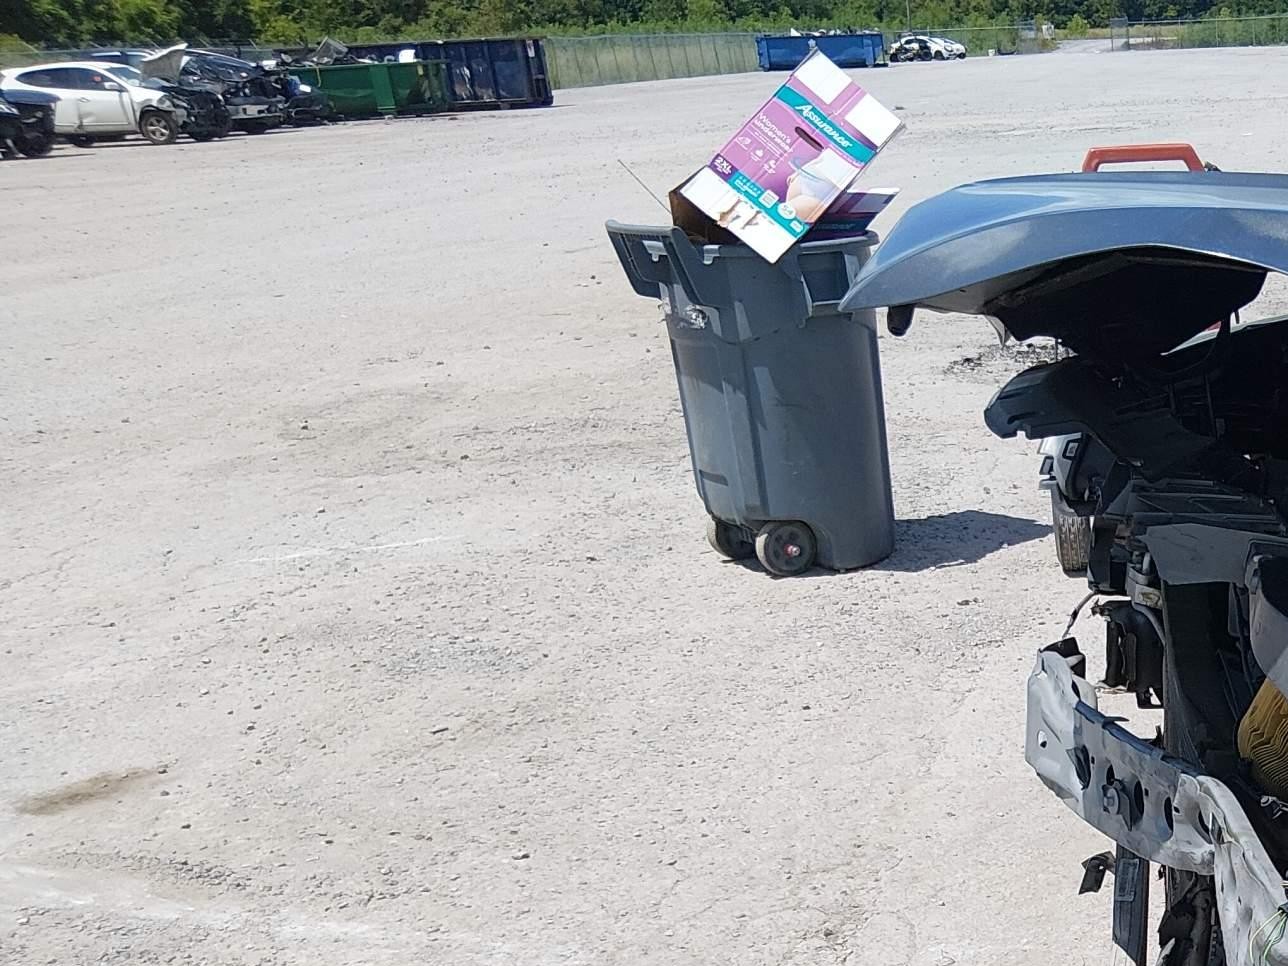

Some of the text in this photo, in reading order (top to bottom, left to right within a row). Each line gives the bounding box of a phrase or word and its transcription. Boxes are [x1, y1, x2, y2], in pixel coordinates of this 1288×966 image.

[759, 112, 791, 143] Women's
[795, 104, 853, 148] Assurance
[715, 156, 732, 171] 2XL
